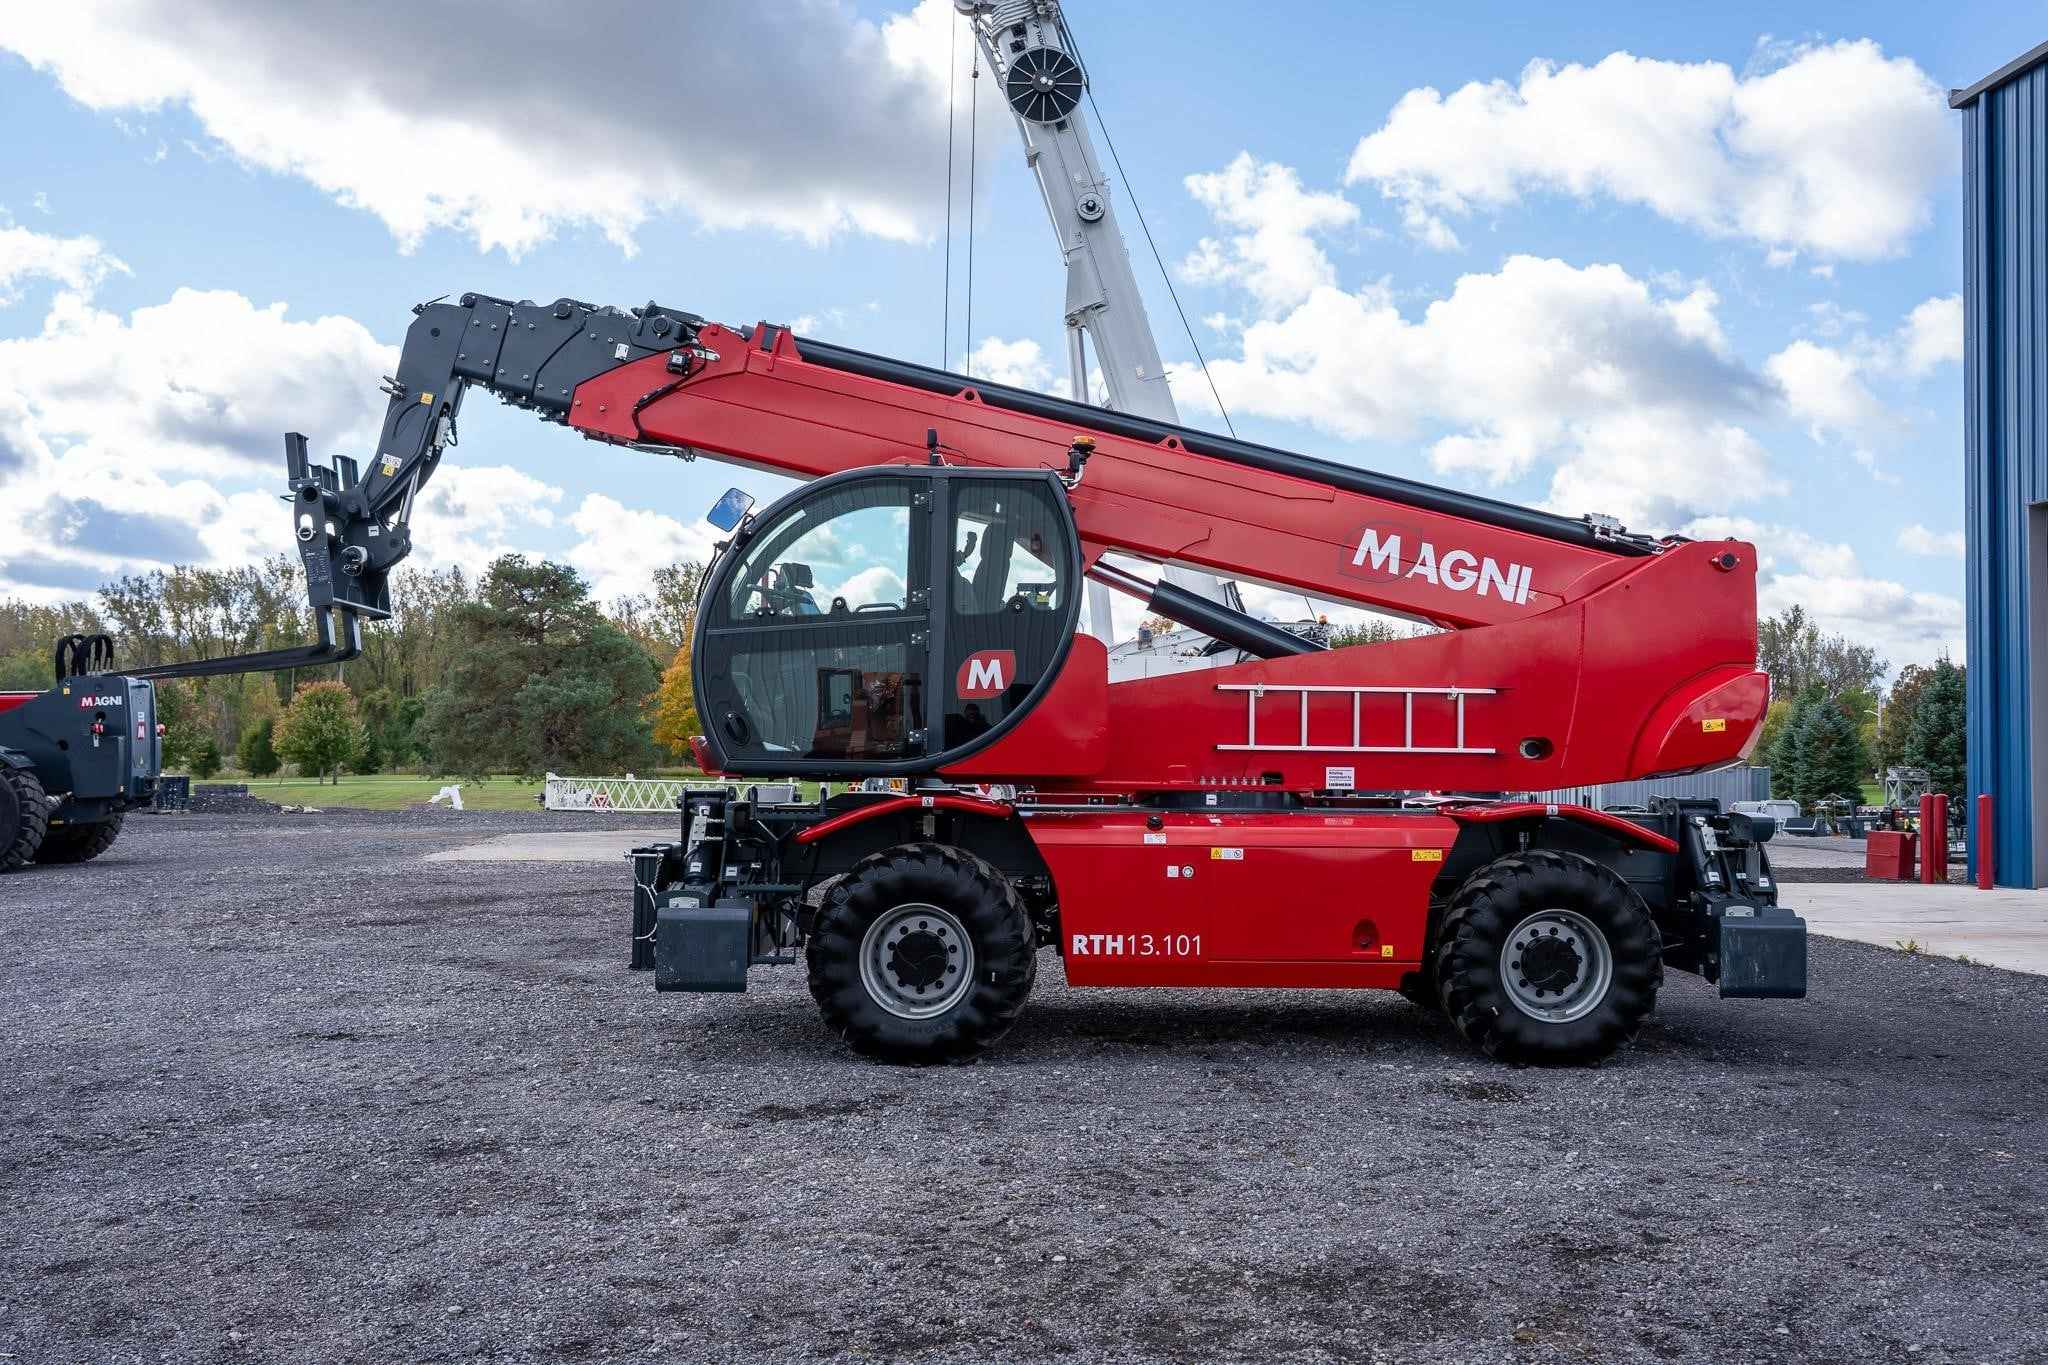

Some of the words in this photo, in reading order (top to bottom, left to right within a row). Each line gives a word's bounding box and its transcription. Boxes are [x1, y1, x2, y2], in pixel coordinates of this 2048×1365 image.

[1352, 528, 1532, 605] MAGNI
[966, 659, 1005, 690] M
[81, 695, 122, 707] MAGNI
[1072, 934, 1201, 956] RTH13.101
